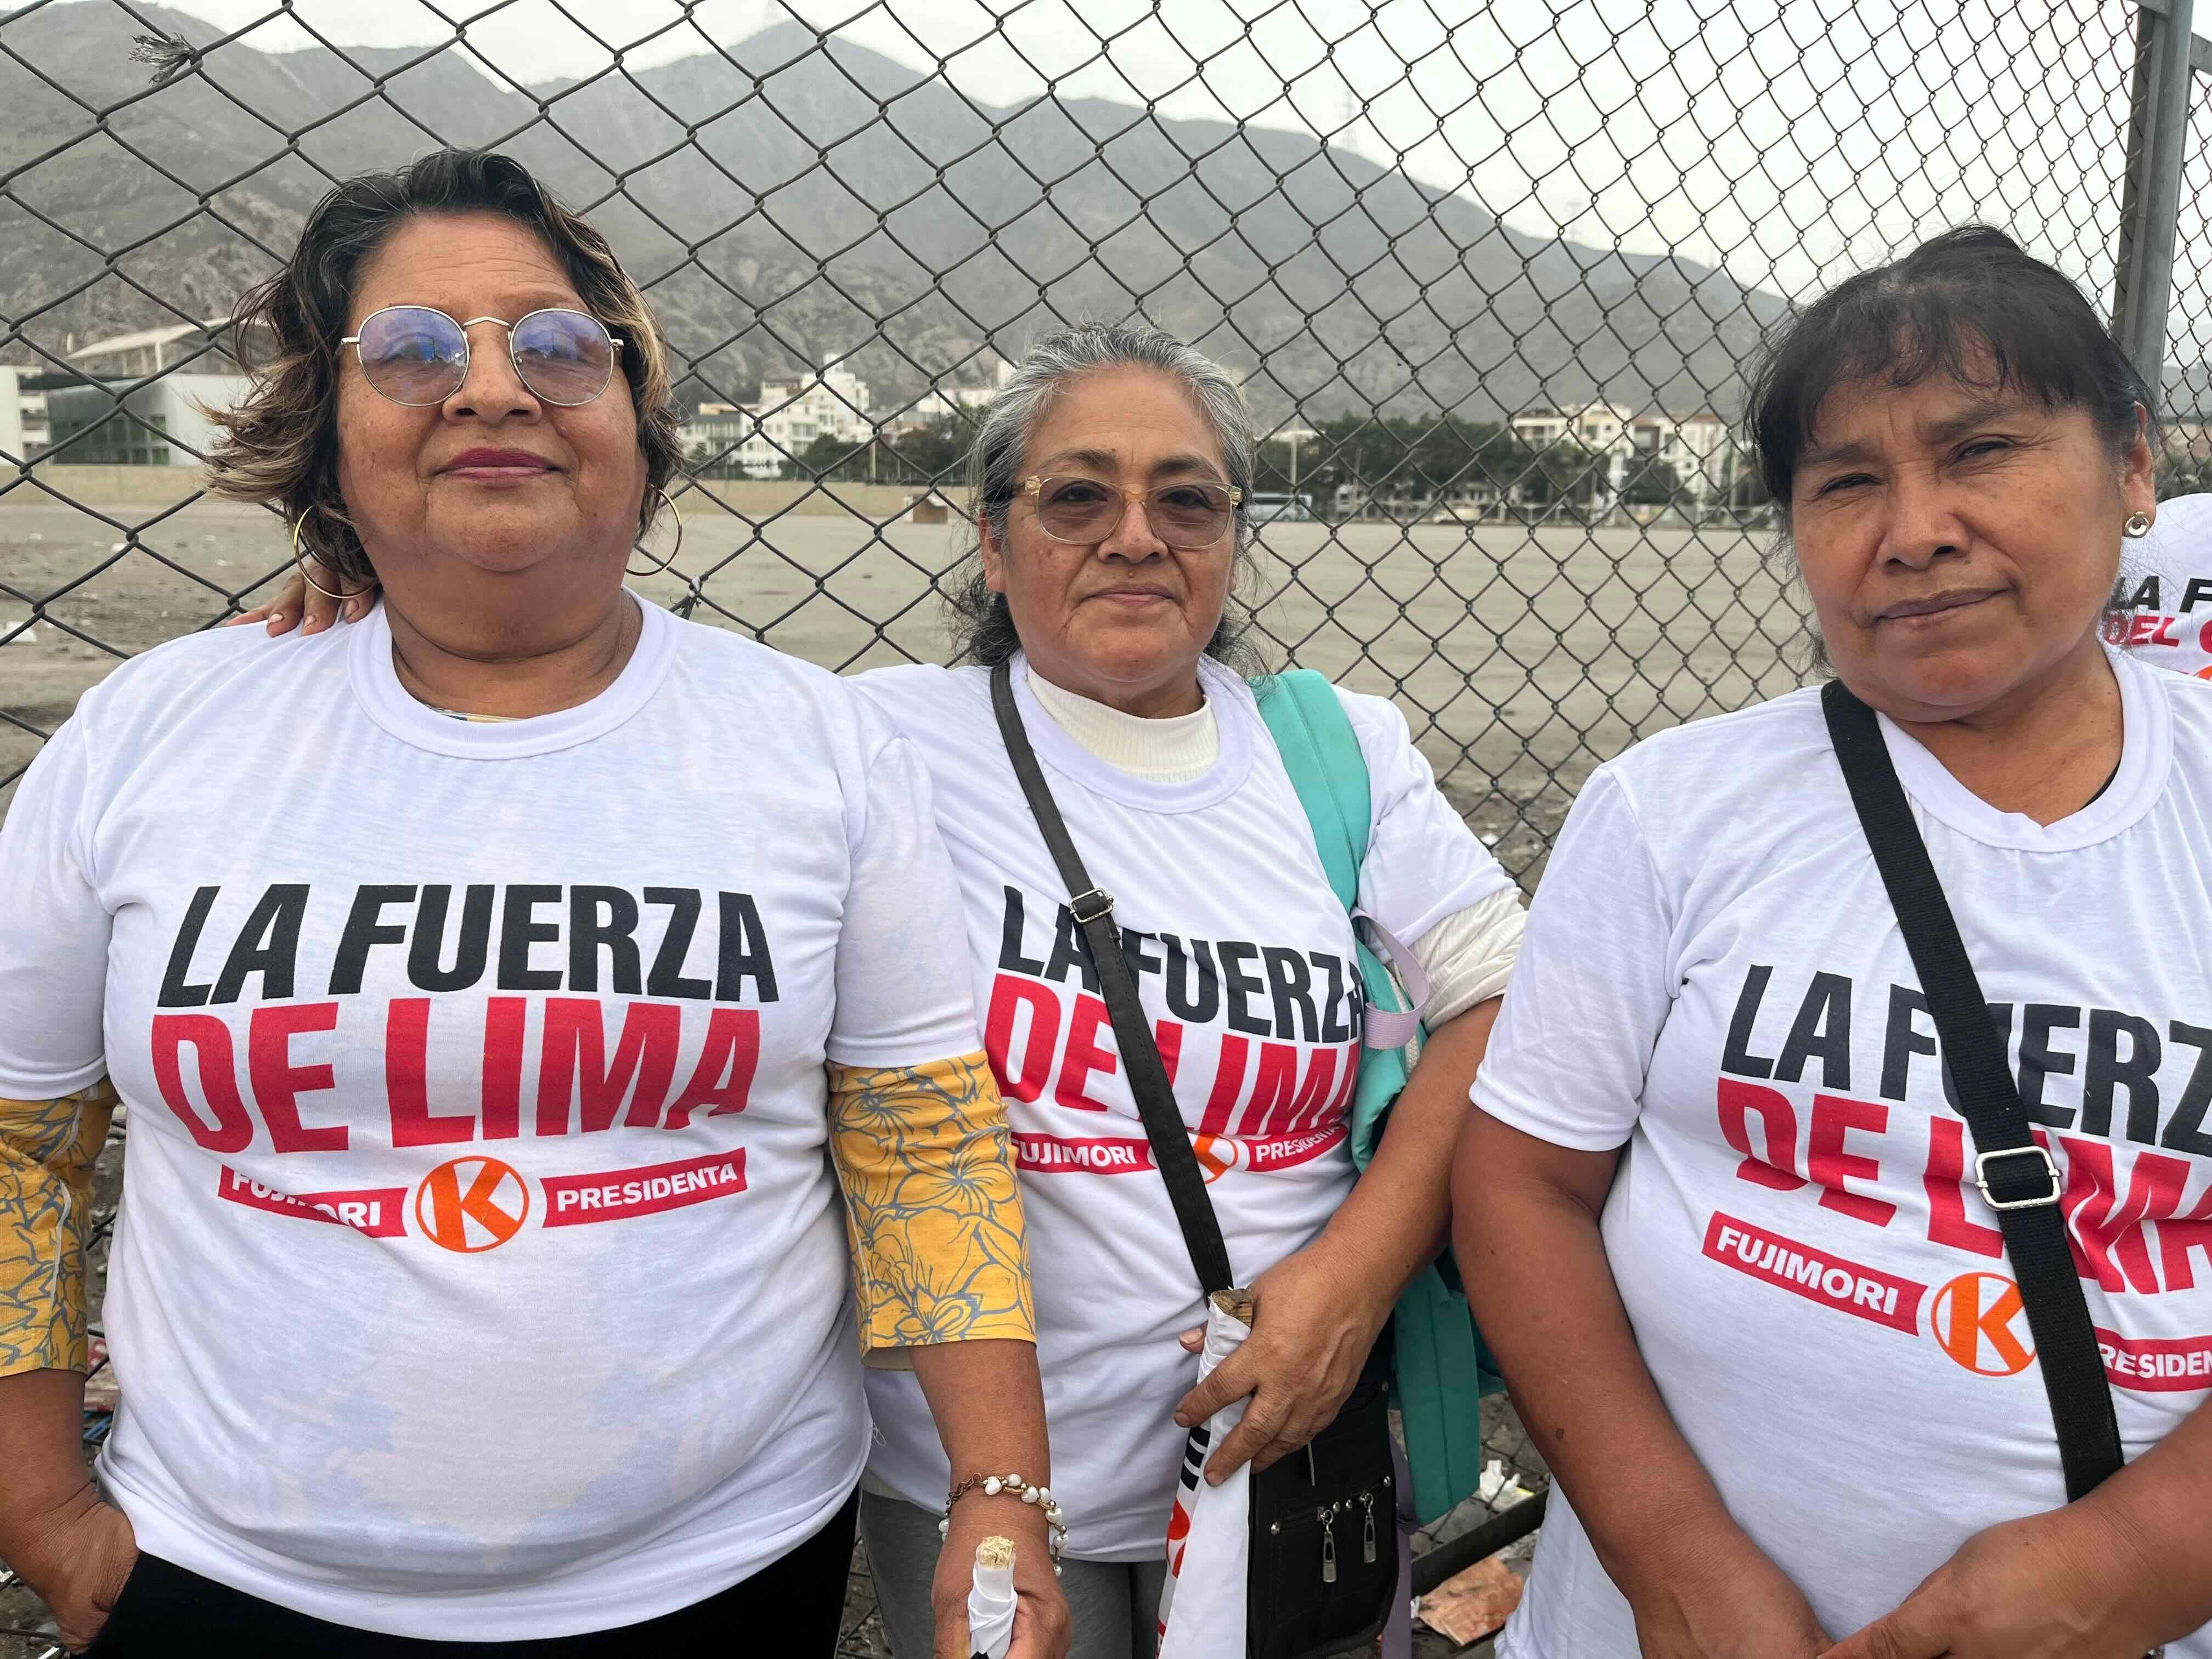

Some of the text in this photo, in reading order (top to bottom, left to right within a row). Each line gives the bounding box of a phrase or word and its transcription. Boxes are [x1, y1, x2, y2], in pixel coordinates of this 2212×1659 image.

[157, 884, 779, 1007] LA FUERZA
[151, 997, 760, 1154] DE LIMA
[985, 974, 1119, 1113] DE
[1720, 964, 1852, 1091] LA
[425, 1156, 522, 1253] K
[557, 1163, 738, 1212] PRESIDENTA
[1011, 1138, 1138, 1167] UJIMORI
[1717, 1077, 1897, 1227] DE
[1717, 1226, 1898, 1316] FUJIMORI
